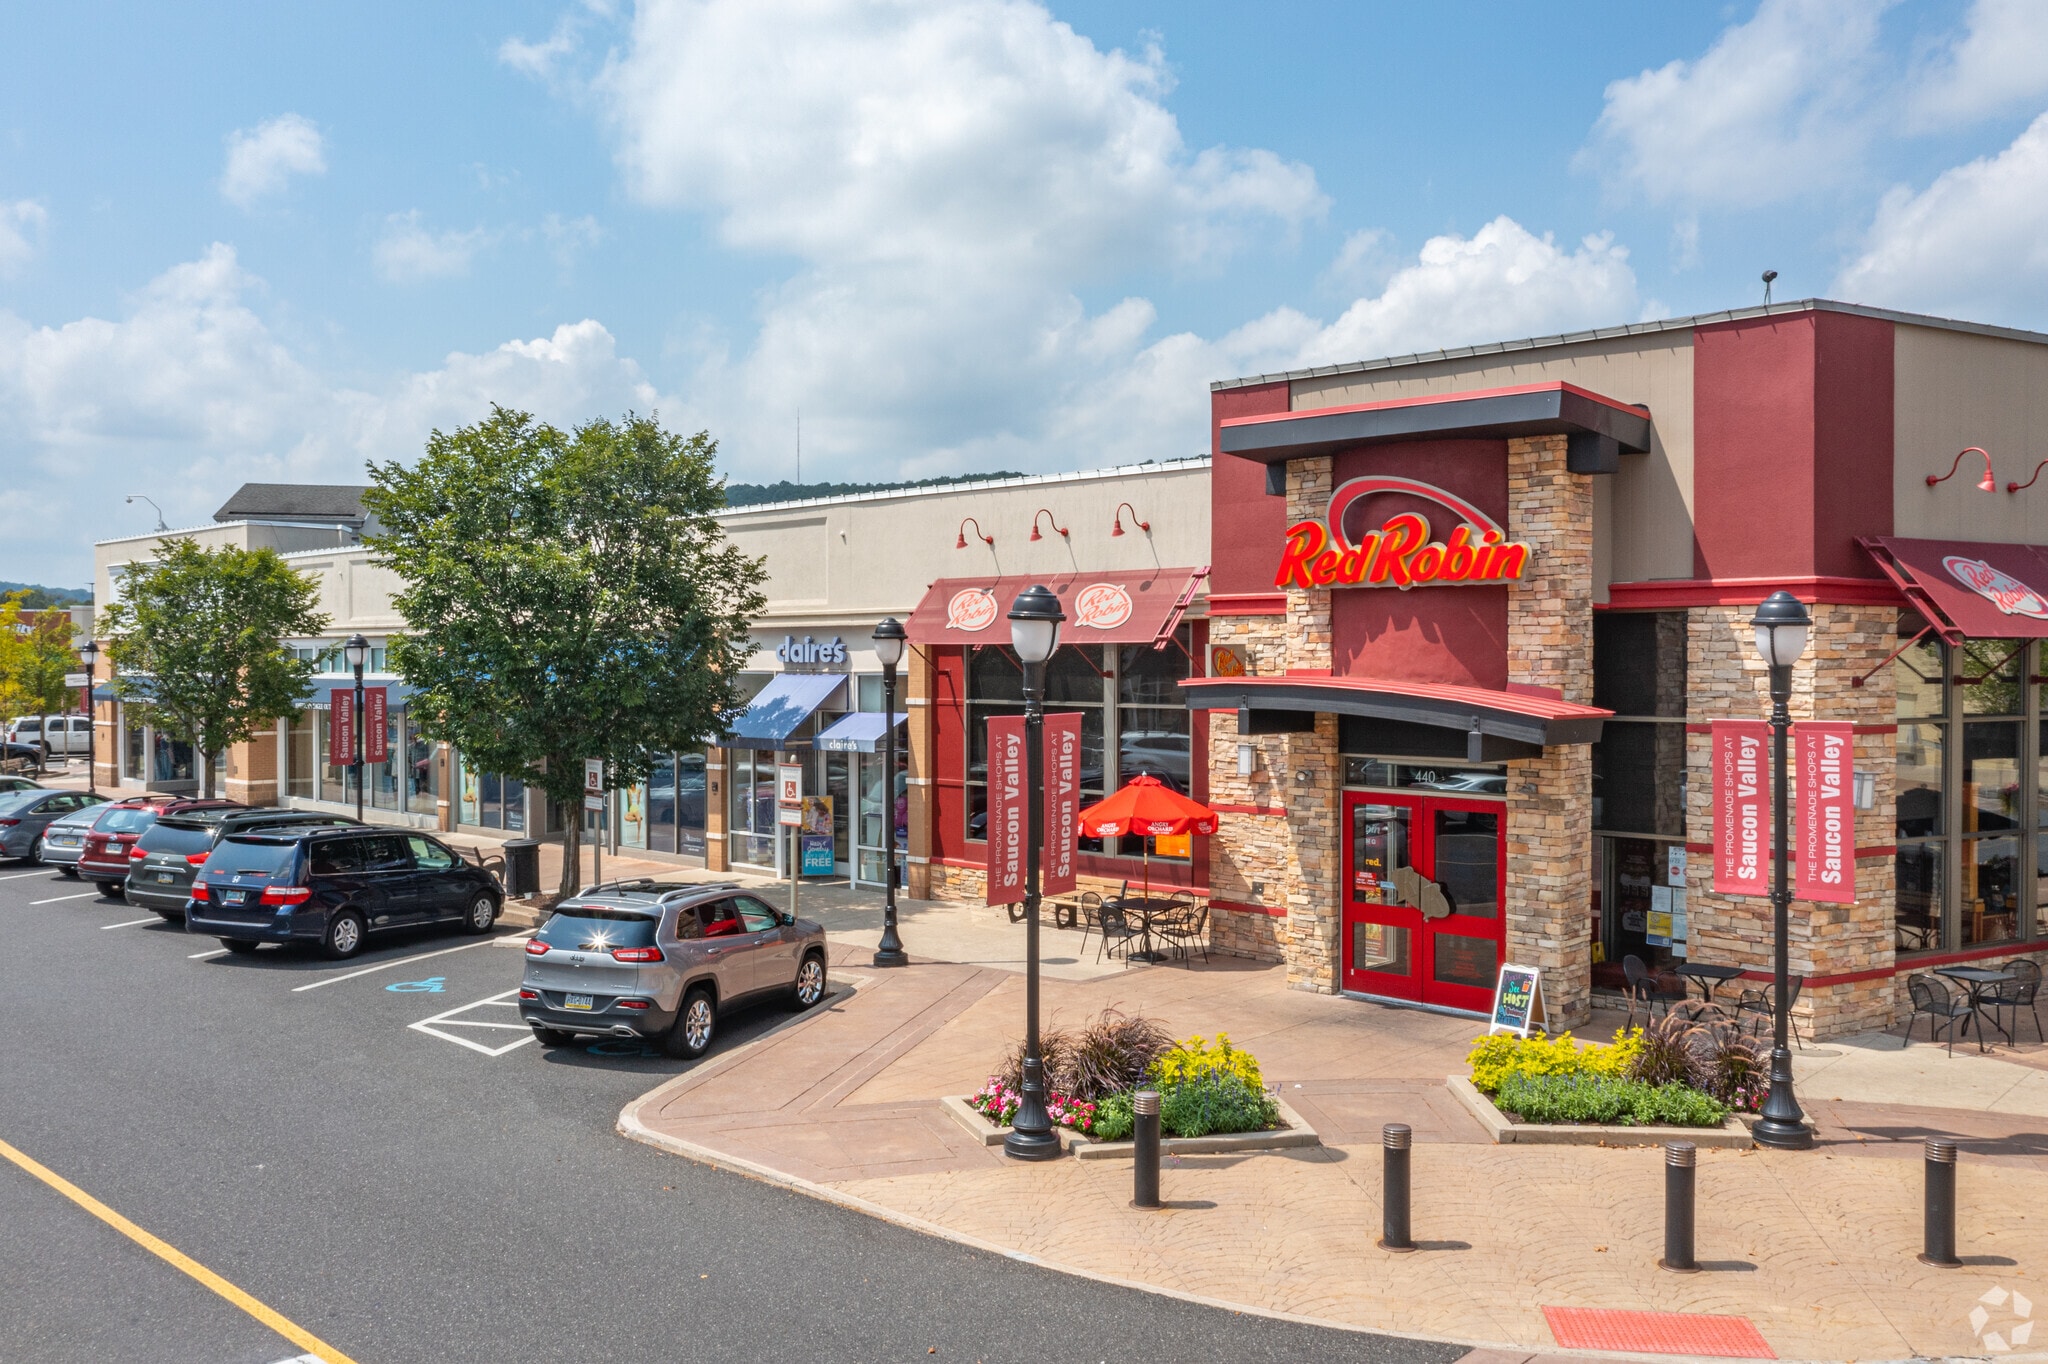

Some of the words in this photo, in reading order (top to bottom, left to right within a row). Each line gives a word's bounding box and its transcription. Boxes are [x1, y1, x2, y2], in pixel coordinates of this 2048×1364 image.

[1274, 521, 1380, 588] Red
[1369, 514, 1528, 587] Robin
[1963, 564, 1994, 589] Red
[956, 592, 989, 611] Red
[1084, 587, 1122, 608] Red
[1989, 583, 2030, 609] Robin
[951, 605, 995, 625] Robin
[1079, 601, 1129, 624] Robin
[776, 635, 847, 663] claire's
[341, 695, 350, 723] Valley
[375, 693, 384, 721] Valley
[340, 725, 349, 759] Saucon
[375, 723, 383, 756] Saucon
[829, 739, 858, 751] claire's
[995, 735, 1002, 749] AT
[1051, 732, 1058, 745] AT
[1724, 736, 1733, 749] AT
[1807, 735, 1816, 749] AT
[995, 752, 1003, 791] SHOPS
[1004, 733, 1021, 800] Valley
[1059, 730, 1076, 795] Valley
[1415, 769, 1436, 783] 440
[1724, 751, 1734, 787] SHOPS
[1737, 735, 1760, 798] Valley
[1807, 751, 1817, 787] SHOPS
[1820, 734, 1845, 799] Valley
[995, 794, 1003, 864] PROMENADE
[1050, 789, 1058, 855] PROMENADE
[1725, 789, 1735, 855] PROMENADE
[1808, 790, 1818, 859] PROMENADE
[1004, 807, 1020, 887] Saucon
[1058, 800, 1072, 878] Saucon
[1737, 804, 1758, 880] Saucon
[1821, 805, 1842, 884] Saucon
[805, 857, 832, 867] FREE
[1725, 855, 1734, 878] THE
[1808, 859, 1817, 882] THE
[1502, 992, 1530, 1008] HOST
[1509, 981, 1520, 993] See
